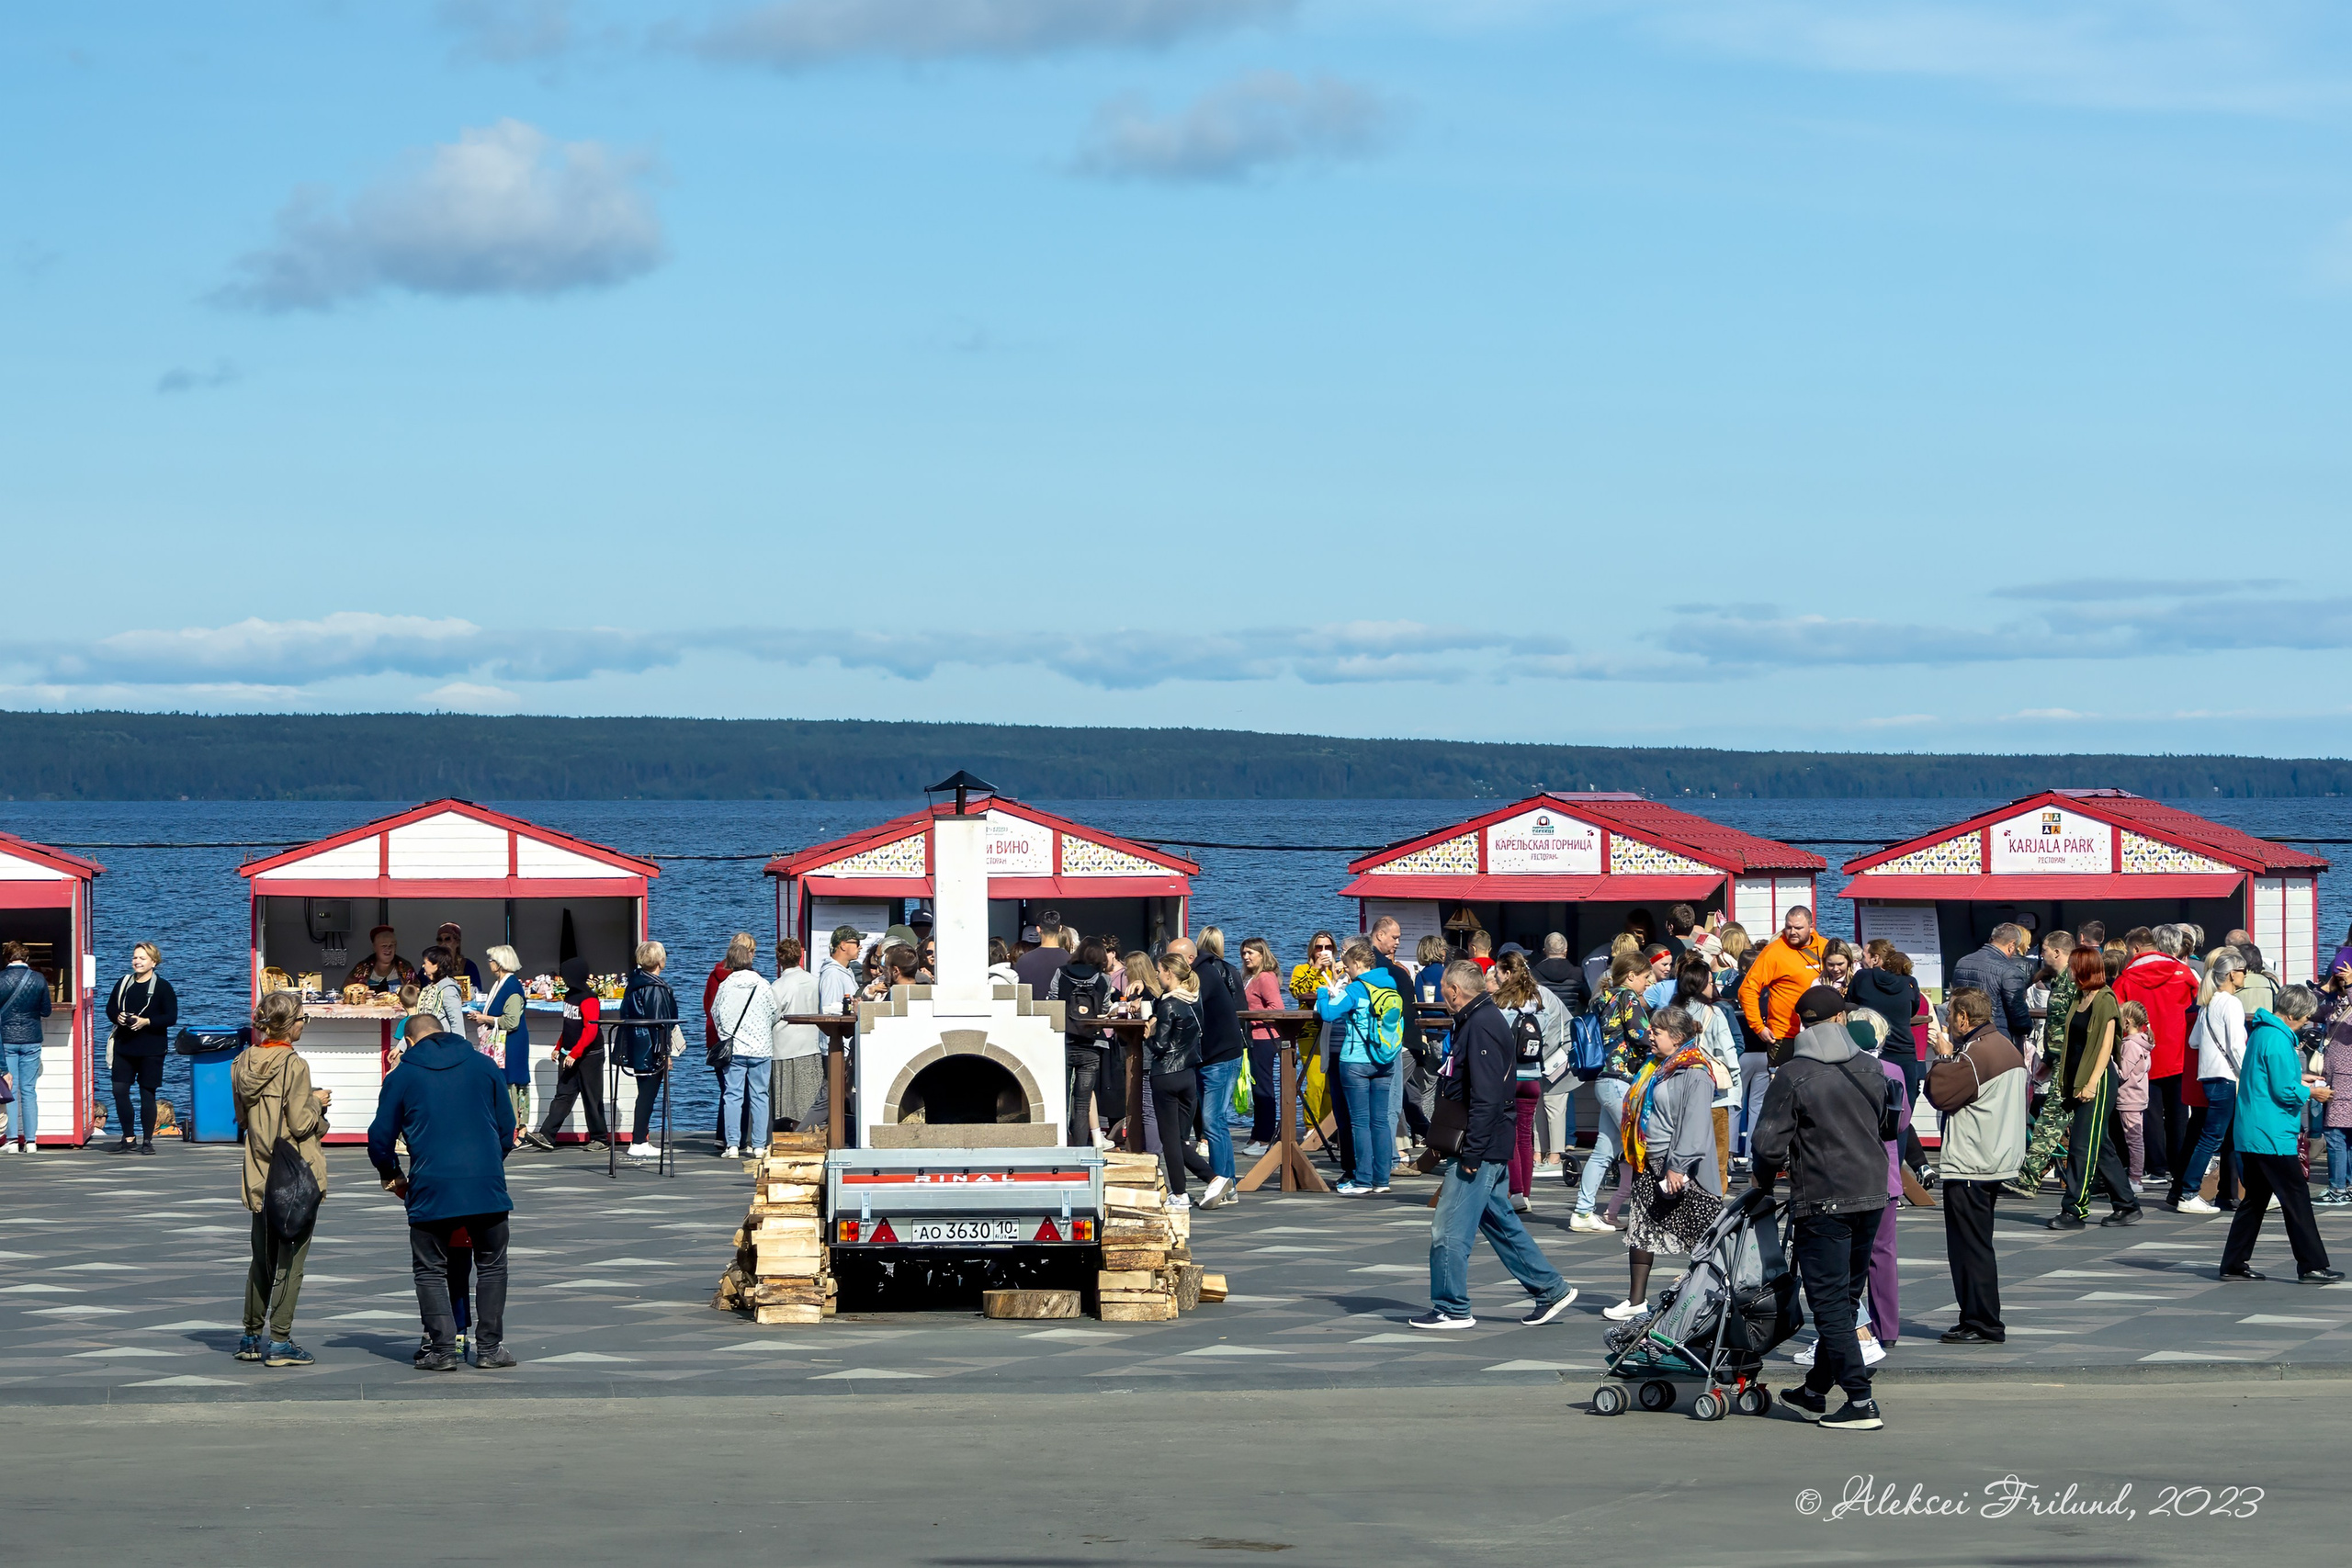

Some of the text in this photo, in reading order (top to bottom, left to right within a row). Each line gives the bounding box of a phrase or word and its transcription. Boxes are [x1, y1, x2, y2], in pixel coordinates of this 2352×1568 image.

[996, 840, 1029, 854] ВИНО
[1496, 839, 1592, 852] КАРЕЛЬСКАЯ ГОРНИЦА
[2009, 839, 2095, 853] KARJALA PARK
[914, 1174, 1015, 1183] RINAL
[945, 1222, 990, 1239] 3630
[996, 1221, 1013, 1235] 10
